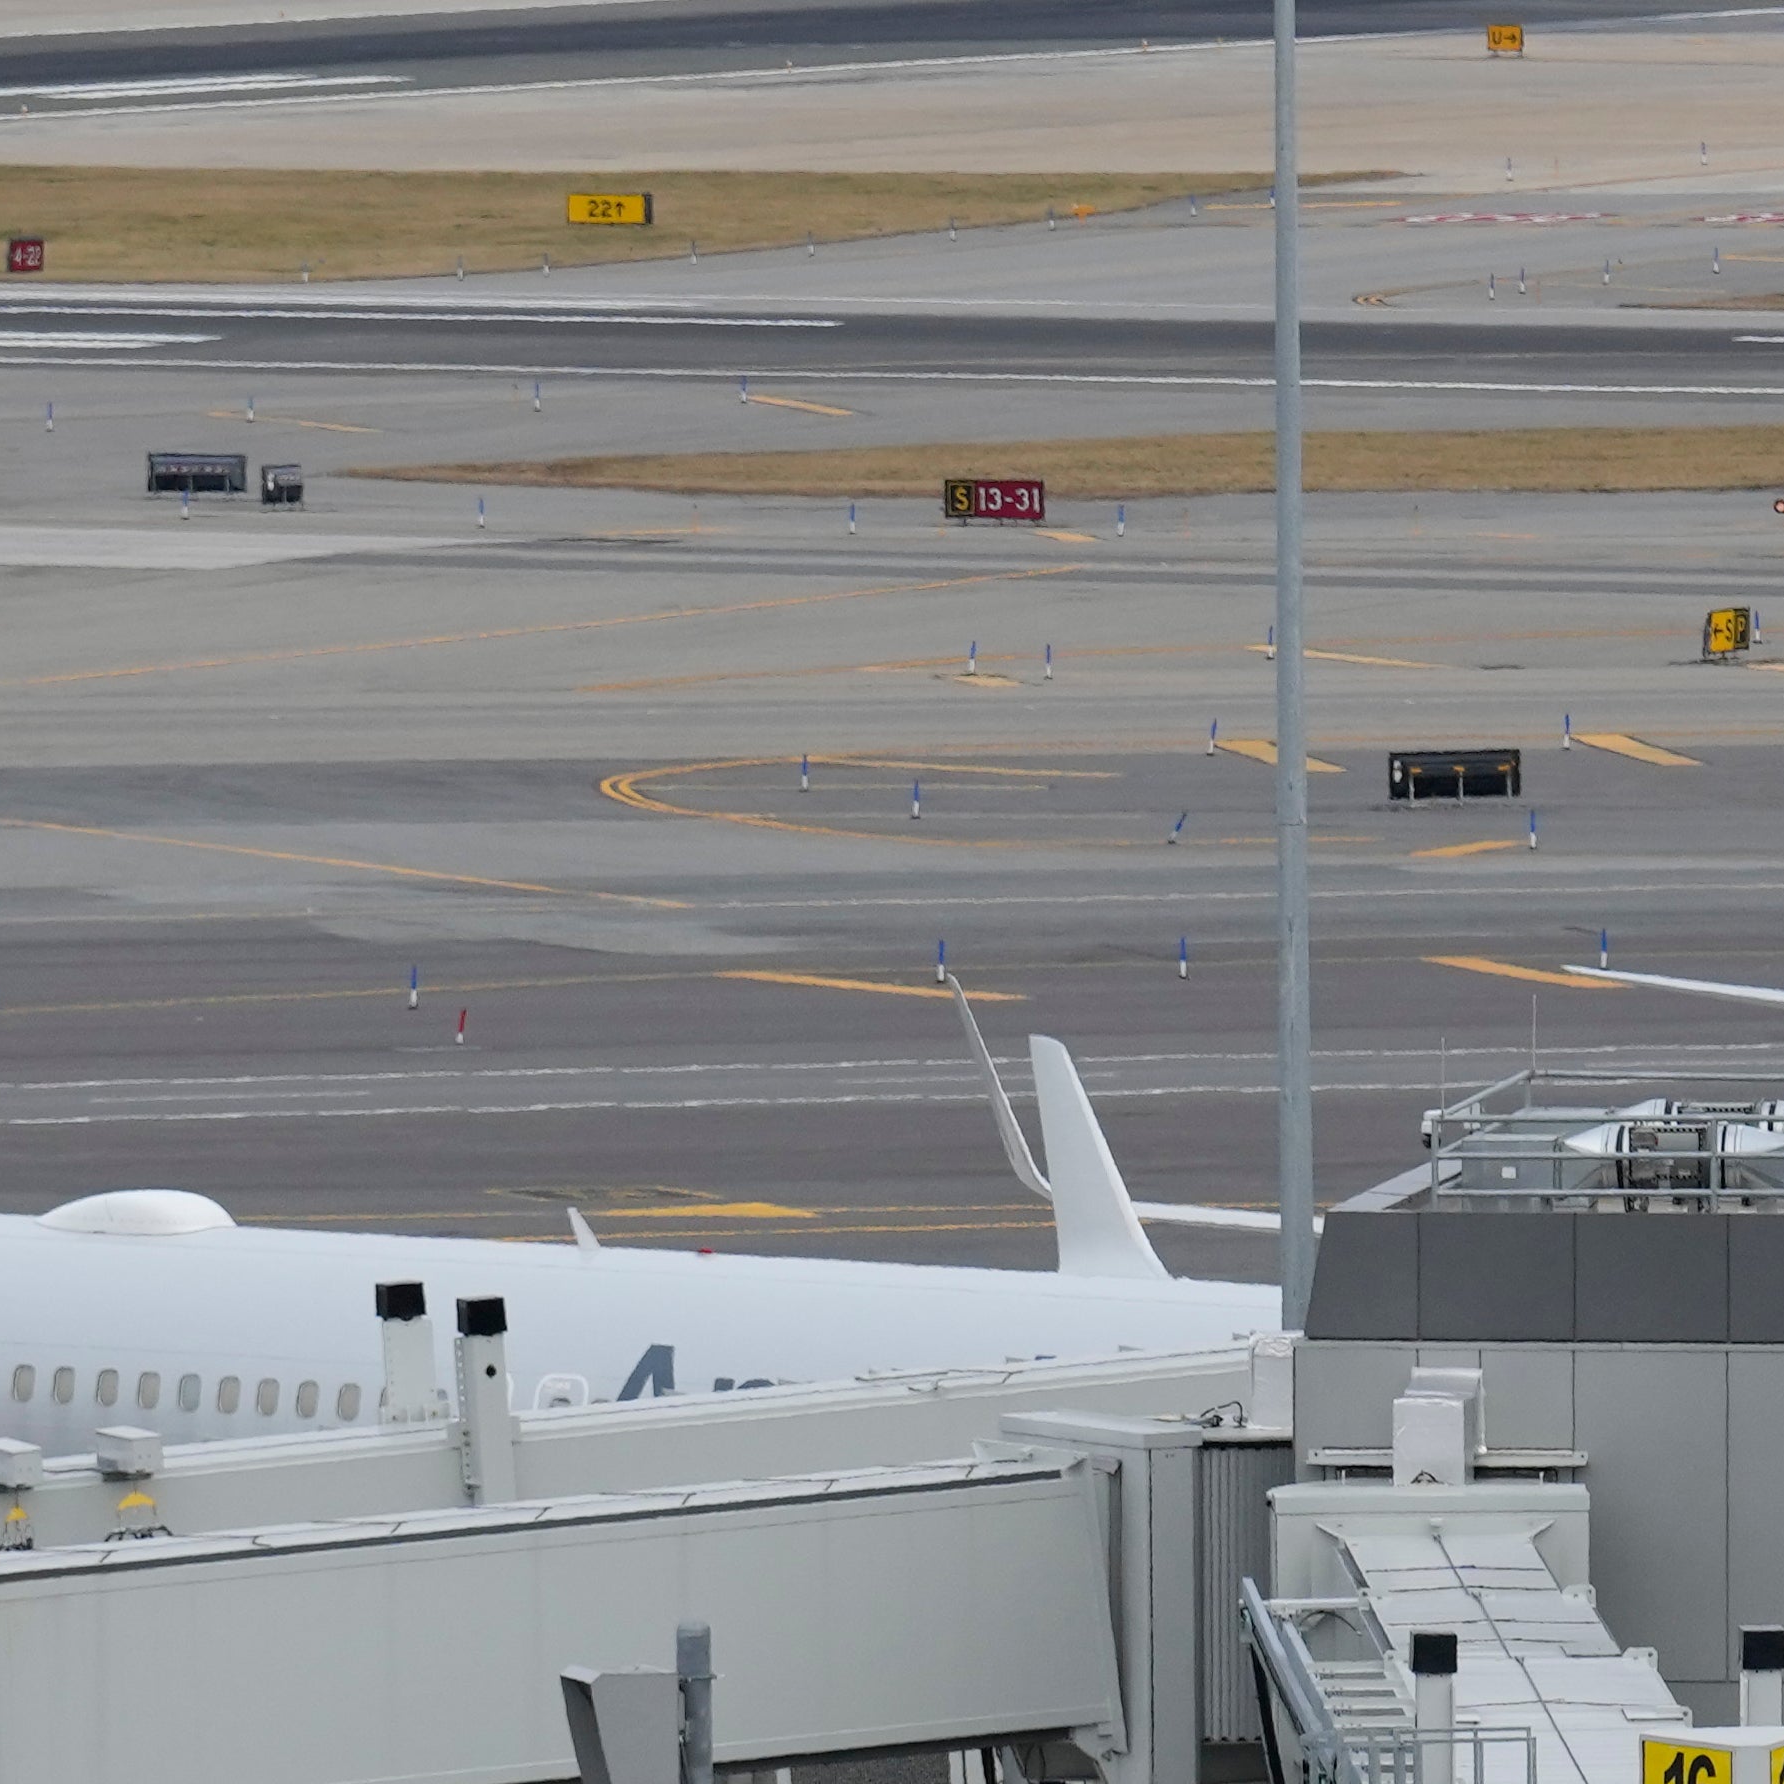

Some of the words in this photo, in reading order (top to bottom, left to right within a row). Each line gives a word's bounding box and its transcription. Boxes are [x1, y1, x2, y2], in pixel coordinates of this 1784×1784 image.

[588, 200, 613, 218] 22
[954, 486, 970, 512] S
[978, 486, 1041, 513] 13-31
[1724, 618, 1734, 643] S
